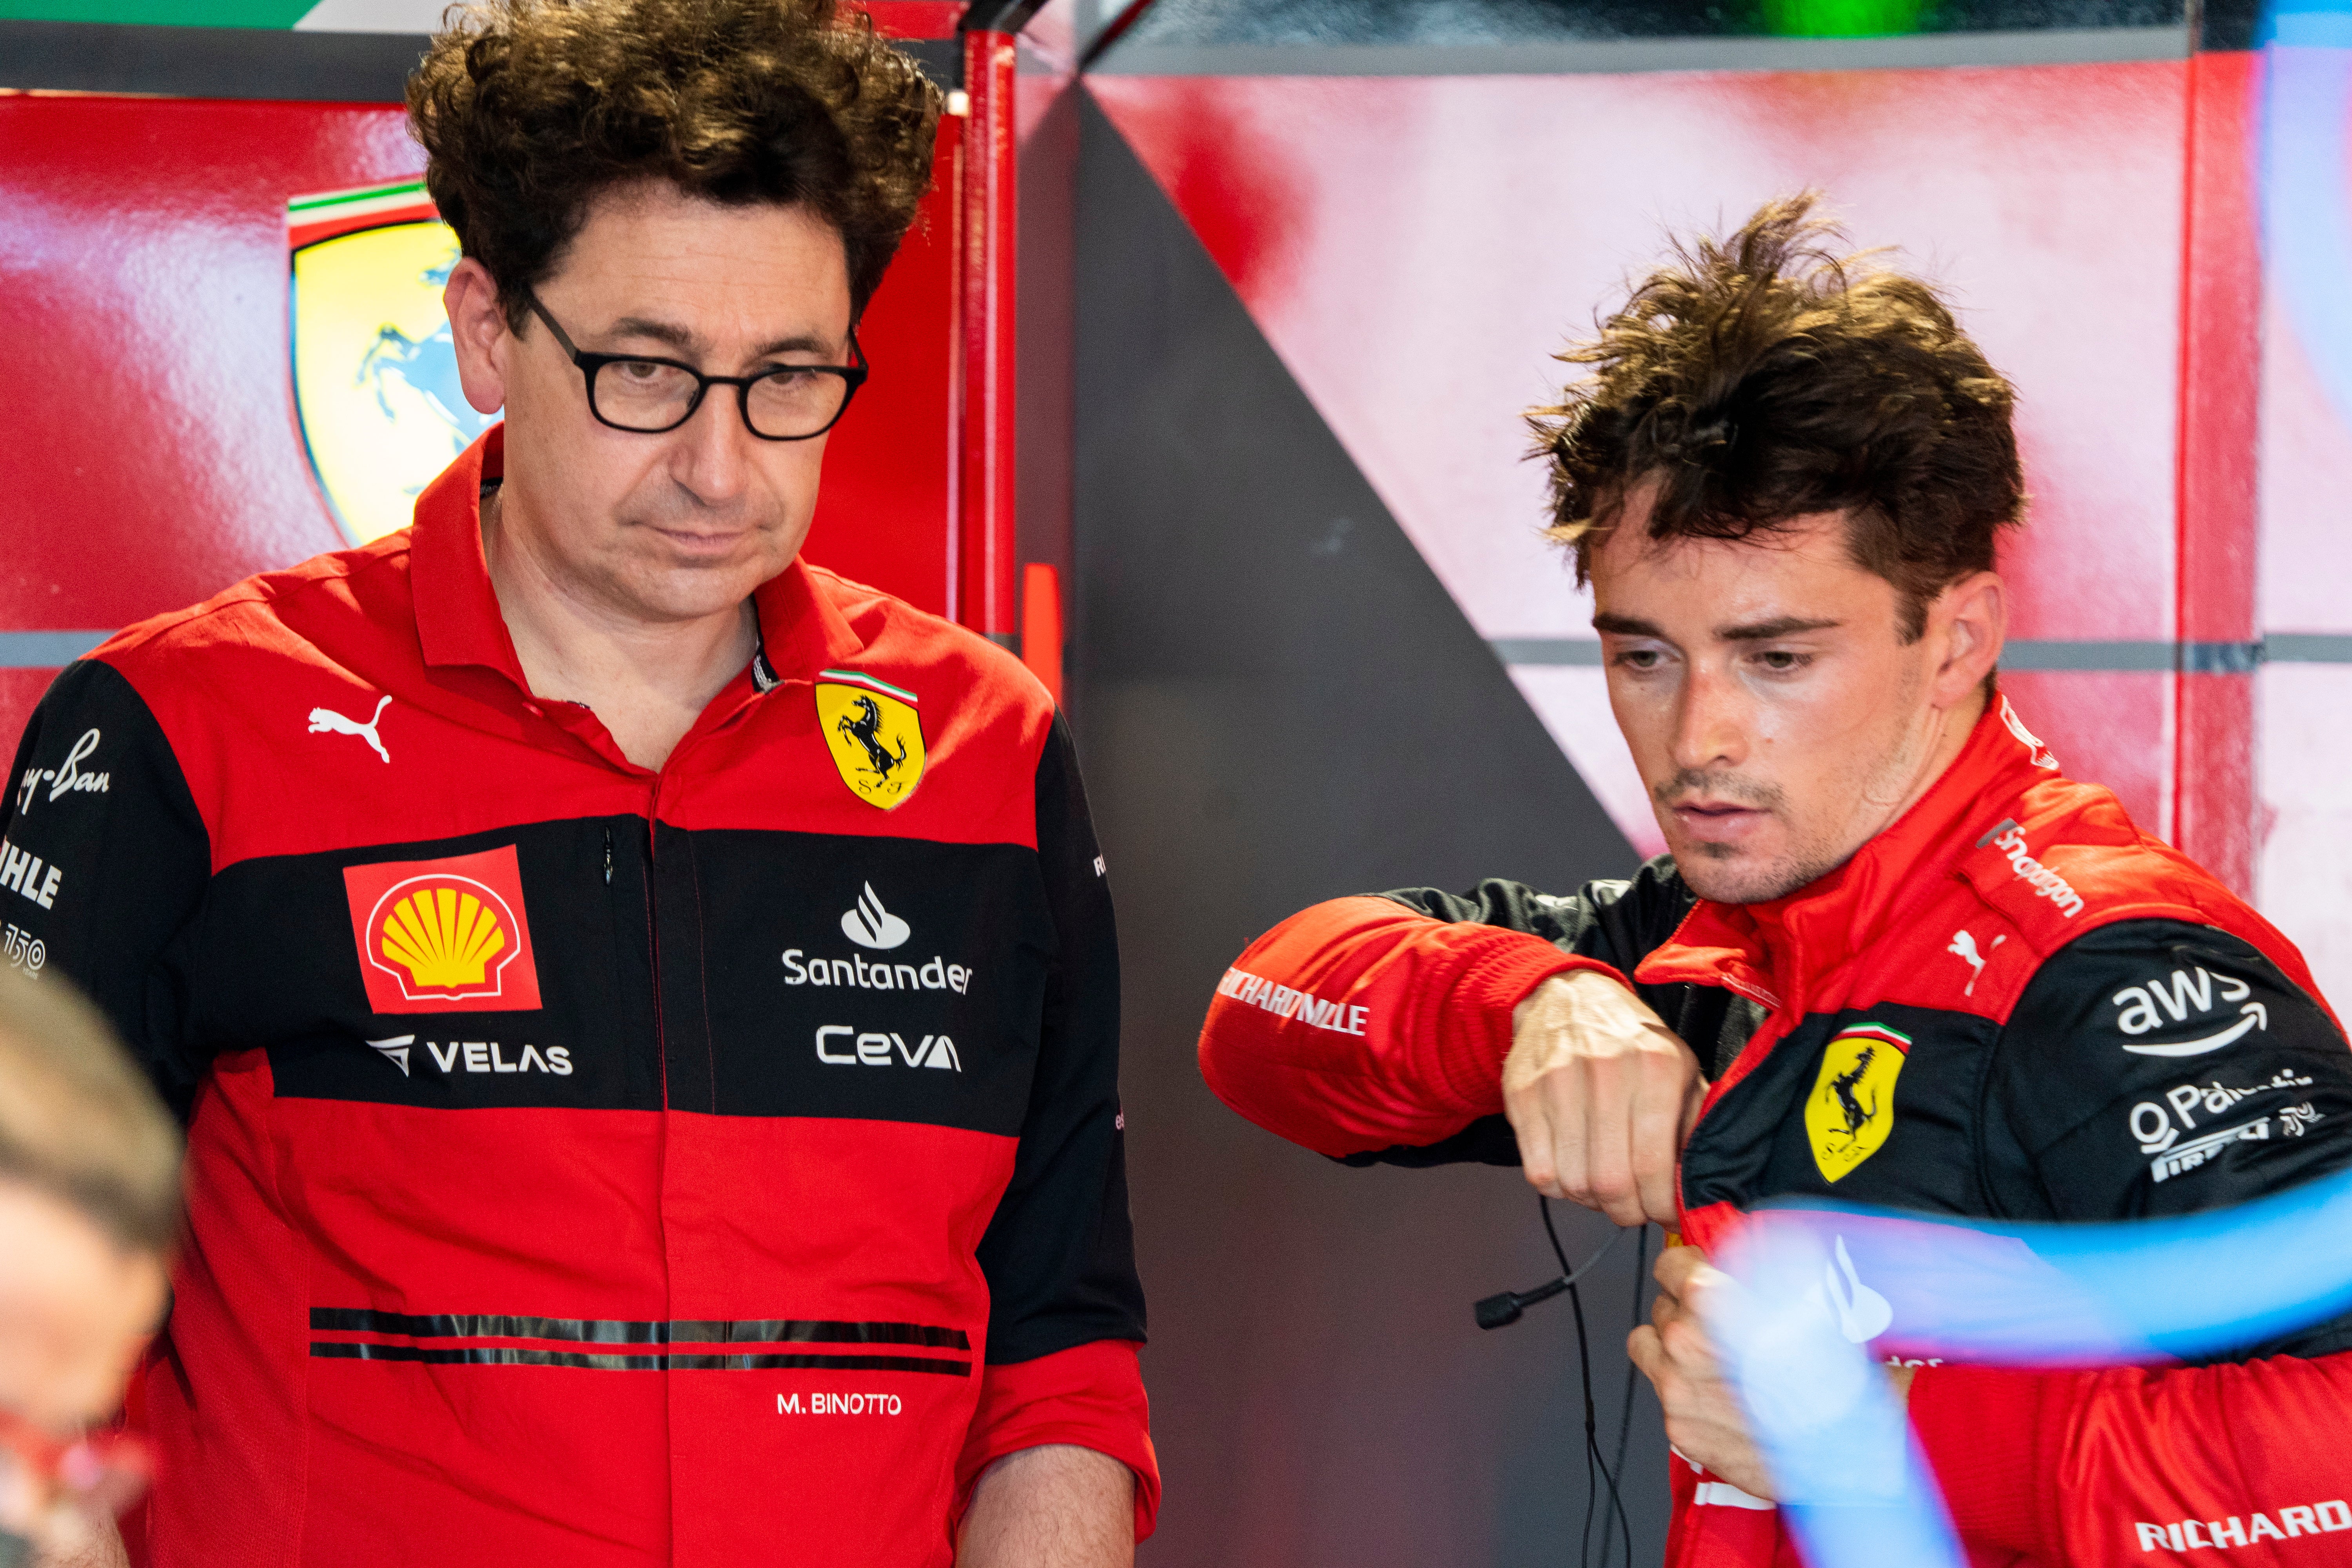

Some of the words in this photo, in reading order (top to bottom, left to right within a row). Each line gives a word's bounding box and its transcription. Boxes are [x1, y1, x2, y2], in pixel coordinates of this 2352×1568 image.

[782, 949, 973, 995] Santander
[2112, 966, 2250, 1035] aws
[426, 1042, 573, 1076] VELAS
[777, 1393, 806, 1414] M.
[811, 1393, 902, 1416] BINOTTO
[2135, 1499, 2352, 1552] RICHARD
